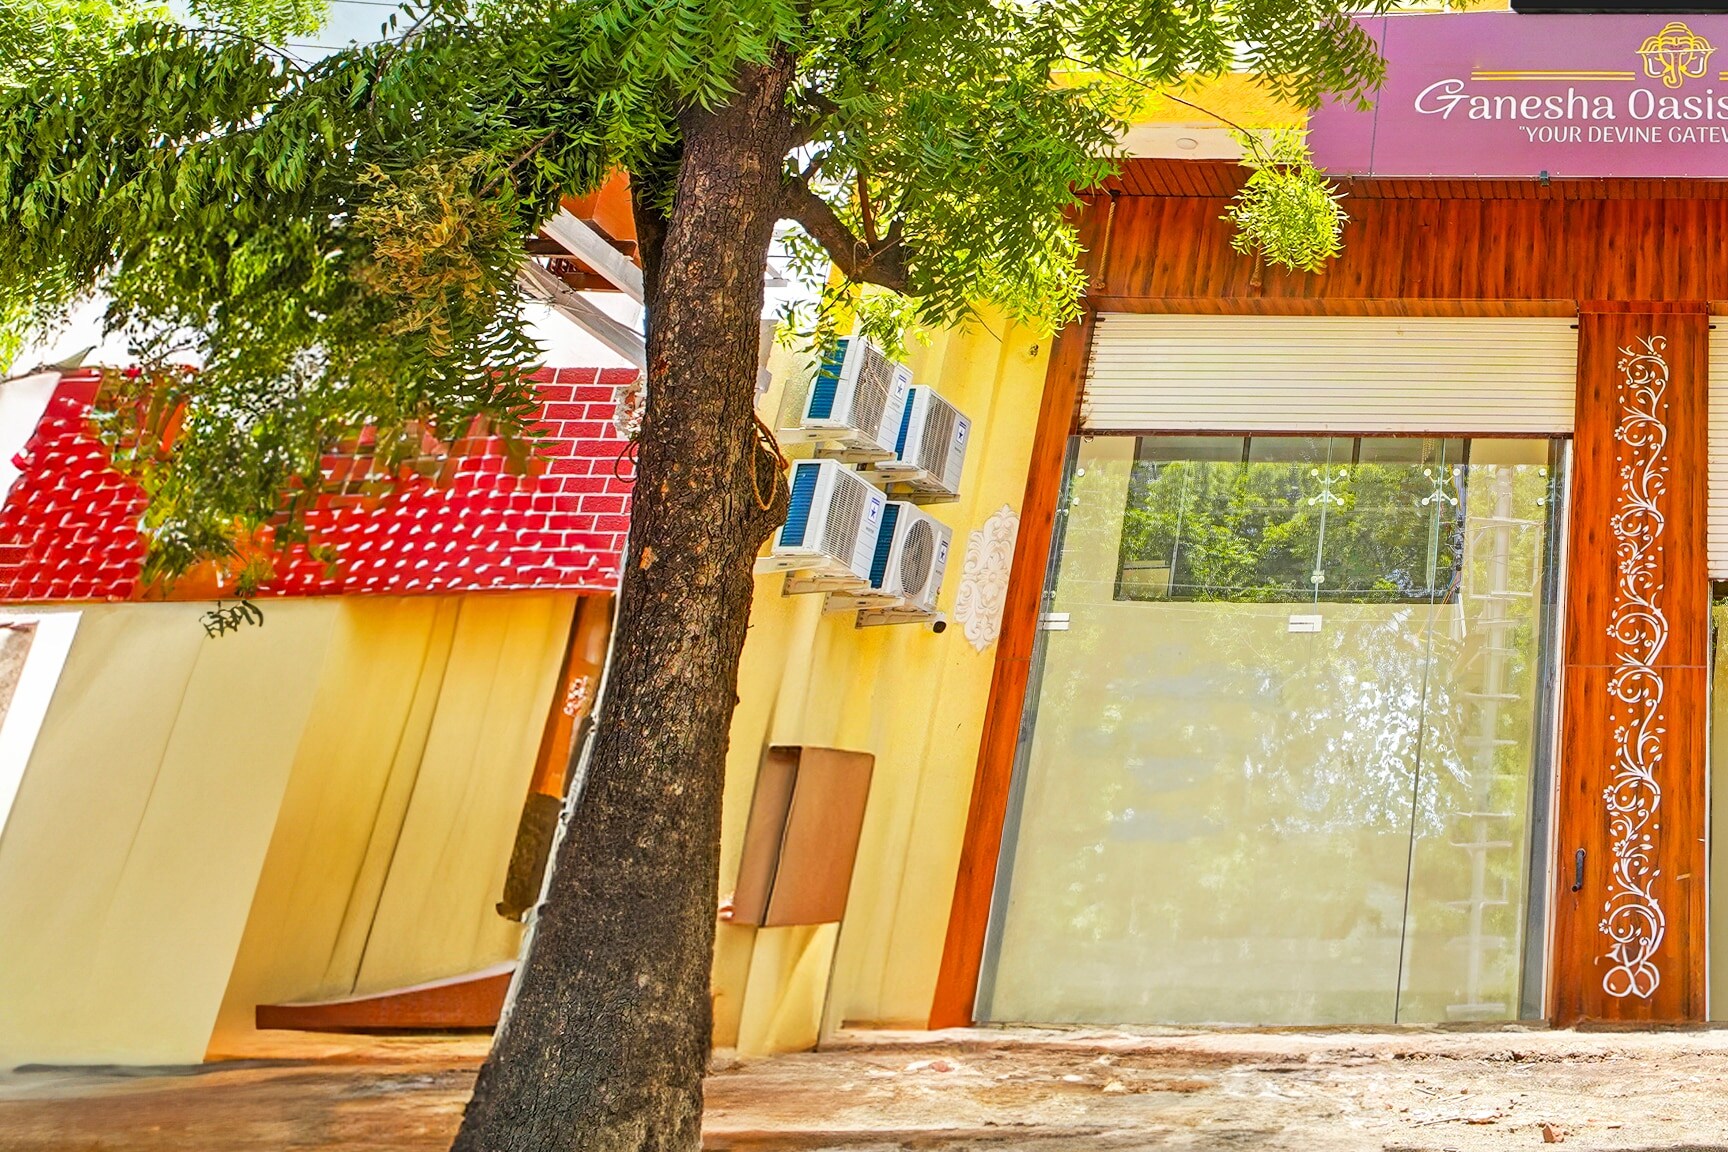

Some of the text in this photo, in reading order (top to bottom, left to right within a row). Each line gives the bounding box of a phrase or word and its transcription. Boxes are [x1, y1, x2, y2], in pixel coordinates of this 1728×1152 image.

[1414, 78, 1616, 121] Ganesha
[1519, 126, 1583, 144] "YOUR
[1588, 127, 1663, 144] DEVINE
